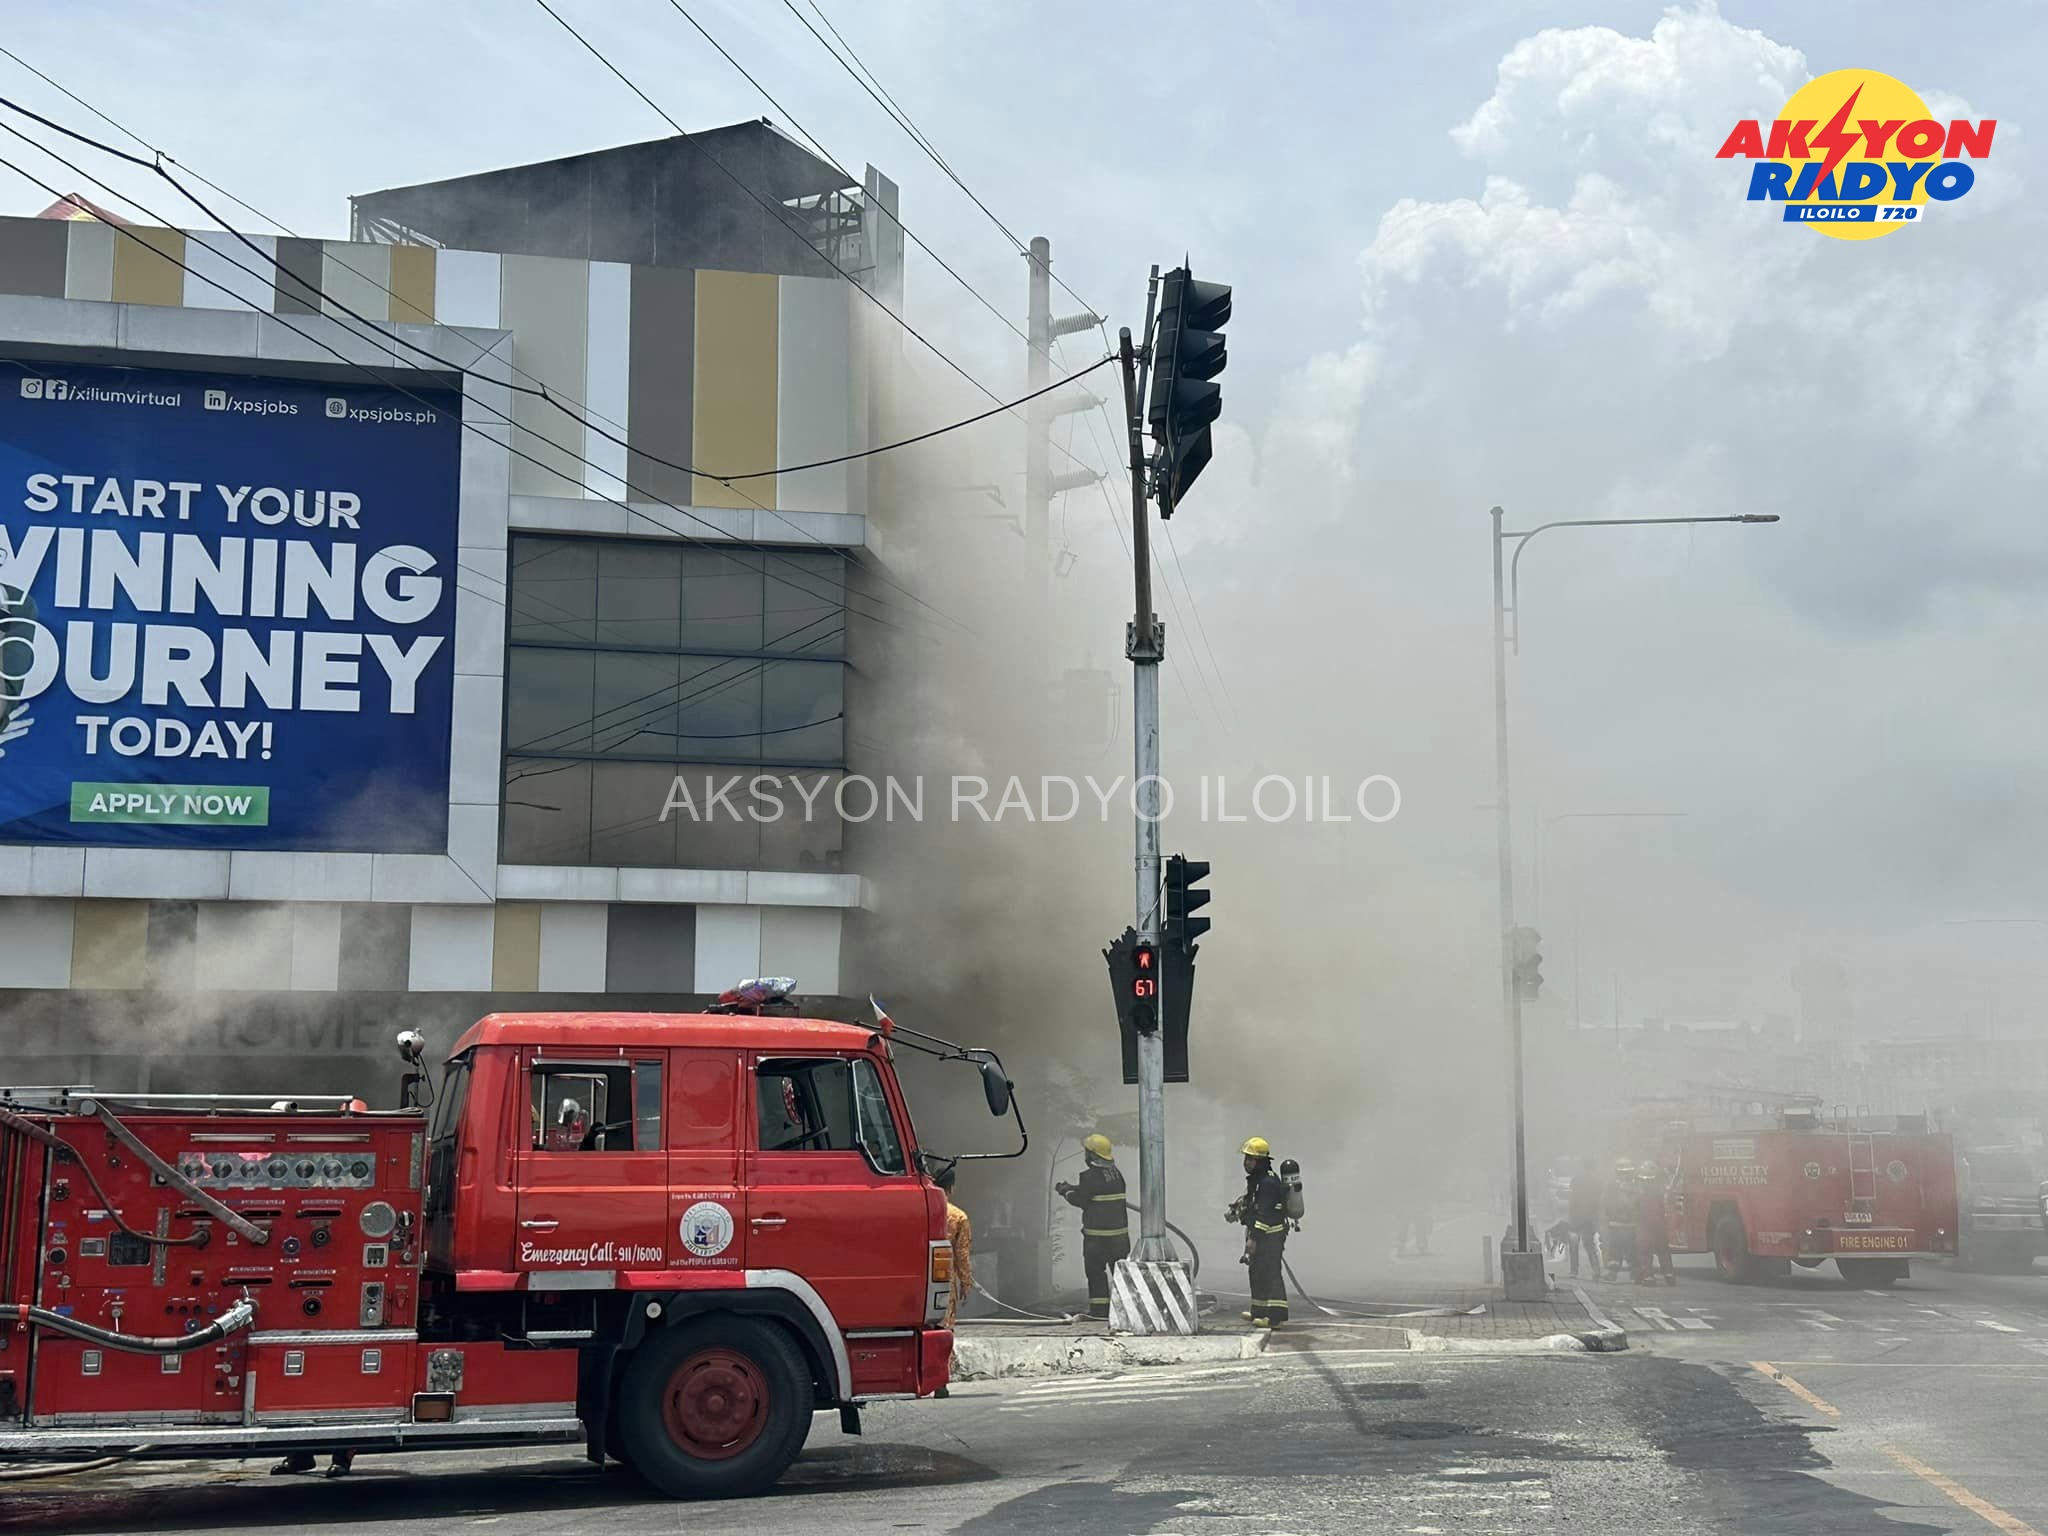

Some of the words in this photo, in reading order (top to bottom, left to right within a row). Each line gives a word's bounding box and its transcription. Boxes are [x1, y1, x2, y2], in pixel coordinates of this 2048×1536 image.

[69, 386, 181, 407] /xiliumvirtual
[226, 396, 298, 415] /xpsjobs
[350, 407, 437, 426] xpsjobs.ph
[24, 473, 202, 520] START
[216, 484, 361, 529] YOUR
[75, 715, 273, 760] TODAY!
[89, 793, 175, 815] APPLY
[183, 795, 252, 816] NOW
[1135, 979, 1153, 996] 67
[1741, 1165, 1768, 1177] CITY
[1840, 1236, 1861, 1248] FIRE
[1862, 1236, 1896, 1248] ENGINE
[1897, 1236, 1908, 1248] 01
[520, 1241, 588, 1266] Emergency
